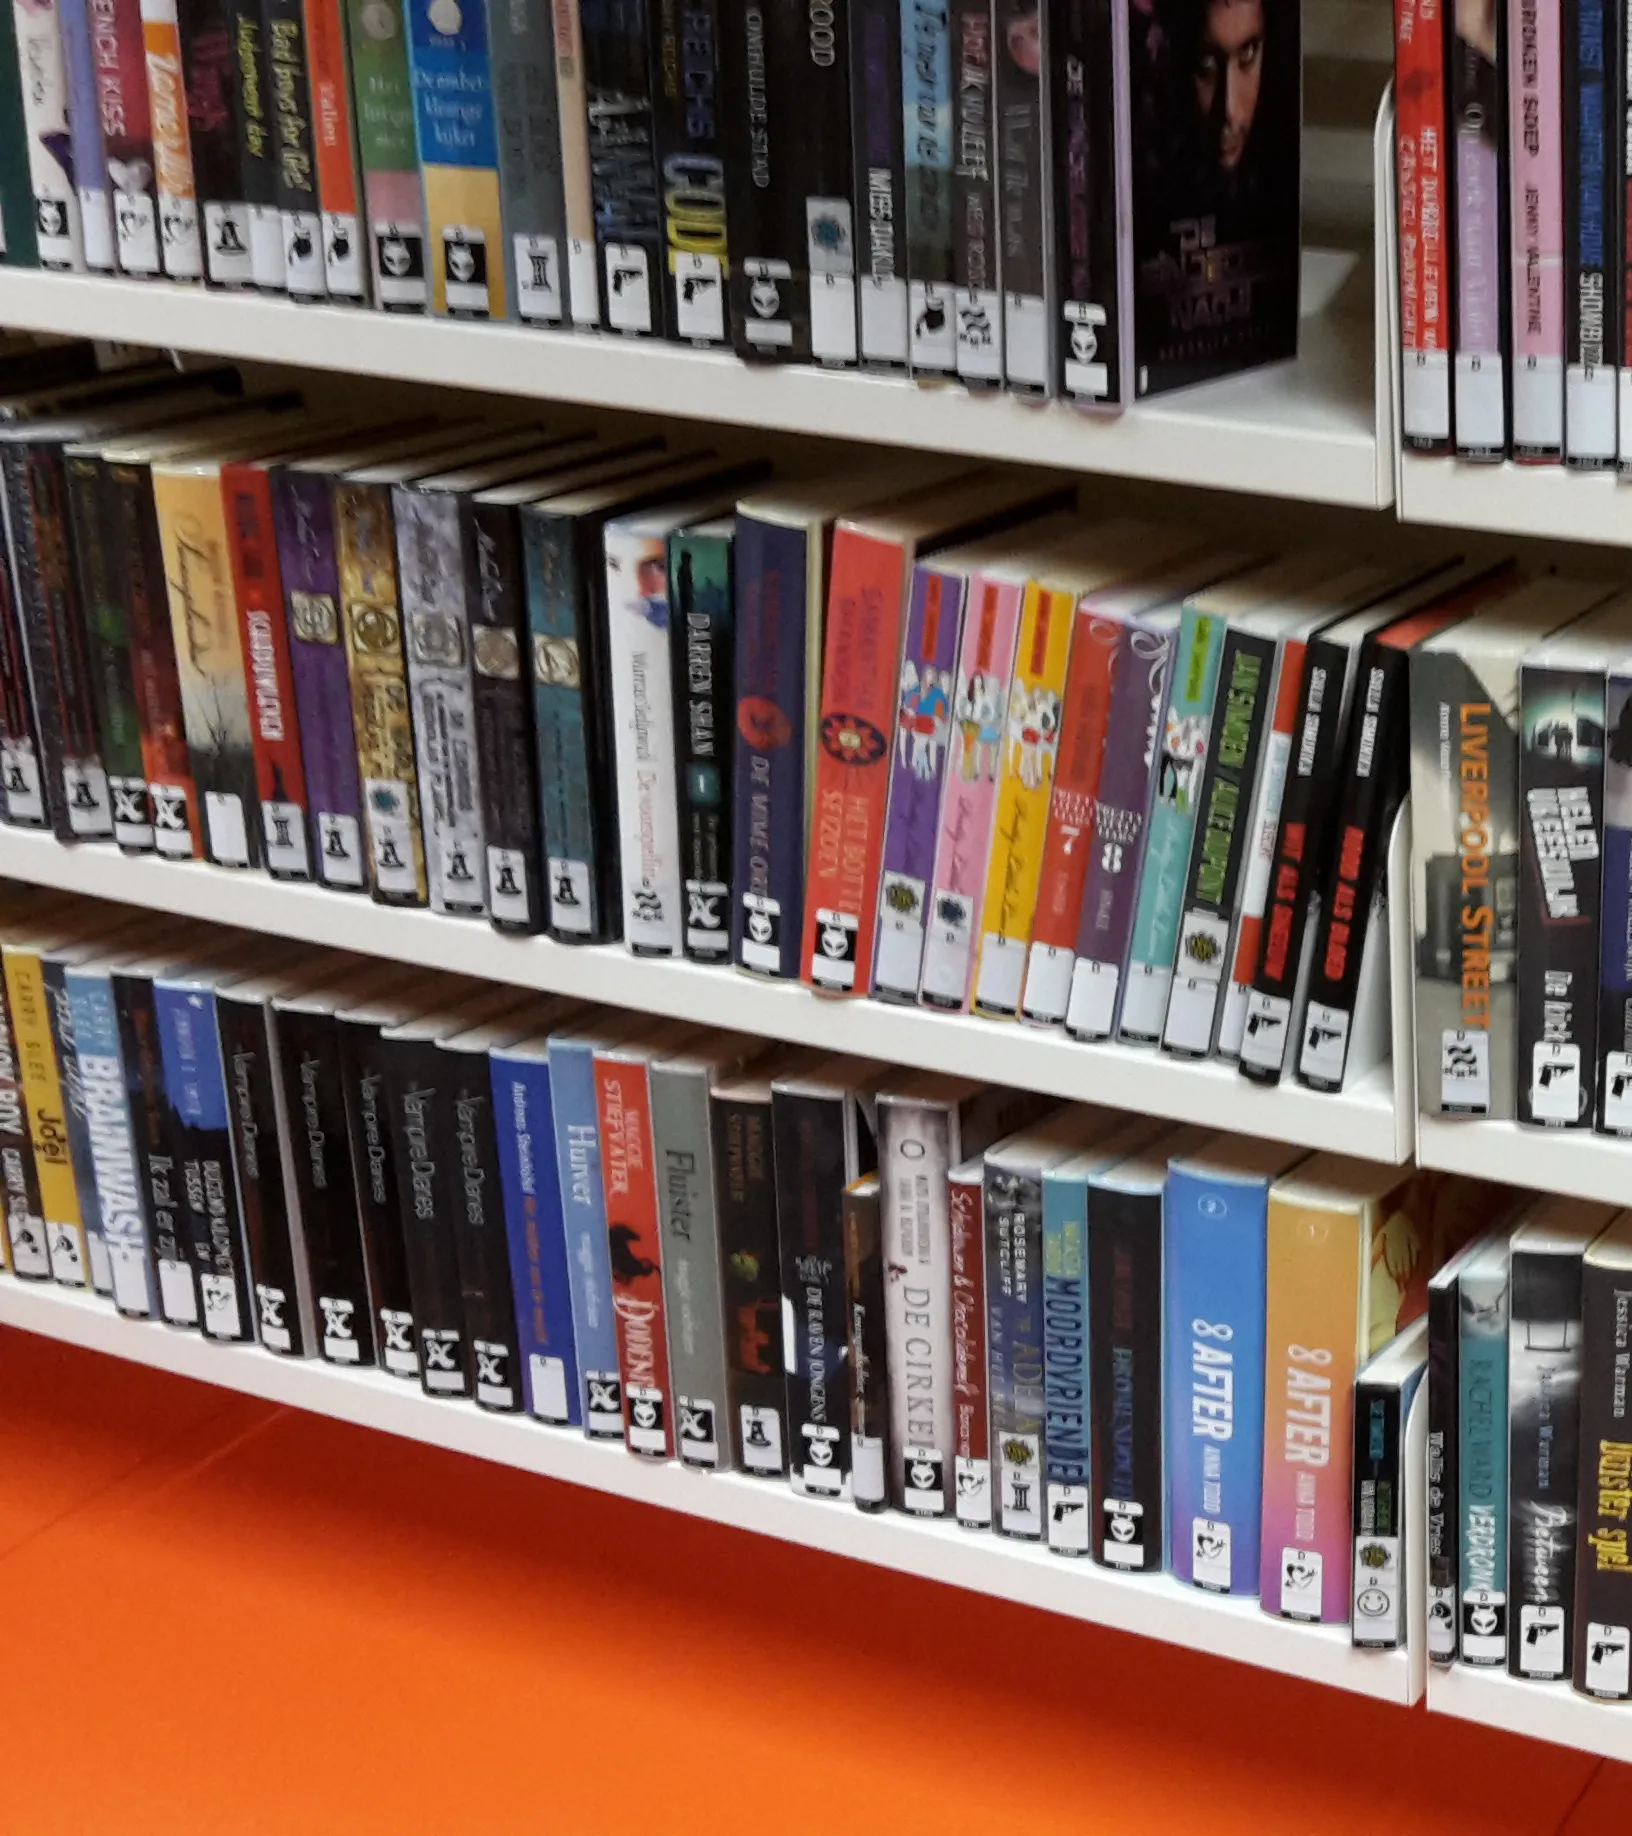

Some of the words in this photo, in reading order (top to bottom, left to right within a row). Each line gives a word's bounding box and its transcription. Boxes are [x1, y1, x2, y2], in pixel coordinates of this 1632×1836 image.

[271, 20, 298, 60] Bad
[103, 76, 126, 138] KISS
[272, 64, 302, 113] boys
[1522, 94, 1542, 158] SOEP
[1525, 244, 1544, 336] VALENTINE
[688, 701, 716, 757] SHAN
[748, 756, 771, 788] DE
[1459, 702, 1494, 894] LIVERPOOL
[818, 788, 844, 878] SEIZOEN
[848, 795, 870, 840] HET
[1557, 786, 1600, 860] HELEN
[1101, 842, 1123, 874] 8
[1526, 788, 1580, 919] VREESWIJK
[1331, 882, 1357, 920] ALS
[1460, 904, 1495, 1029] STREET
[1543, 970, 1574, 995] De
[14, 969, 43, 1028] CARRY
[25, 1040, 48, 1084] SLEE
[359, 1075, 384, 1143] Vampire
[603, 1078, 627, 1197] STIEFVATER
[78, 1053, 146, 1262] BRAINWASH
[148, 1153, 173, 1178] Ik
[566, 1124, 599, 1207] Huiver
[153, 1178, 177, 1208] zal
[664, 1149, 699, 1243] Fluister
[998, 1215, 1012, 1296] SUTCLIFF
[1012, 1212, 1028, 1304] ROSEMARY
[902, 1286, 930, 1328] DE
[1192, 1341, 1234, 1442] AFTER
[1612, 1352, 1632, 1419] Warman
[1284, 1366, 1331, 1468] AFTER
[1203, 1443, 1221, 1480] ANNA
[1428, 1430, 1445, 1482] Wallis
[1467, 1439, 1494, 1498] WARD
[1537, 1425, 1554, 1491] Warman
[1202, 1480, 1221, 1514] TODD
[1429, 1486, 1443, 1509] de
[1429, 1513, 1445, 1557] Vries
